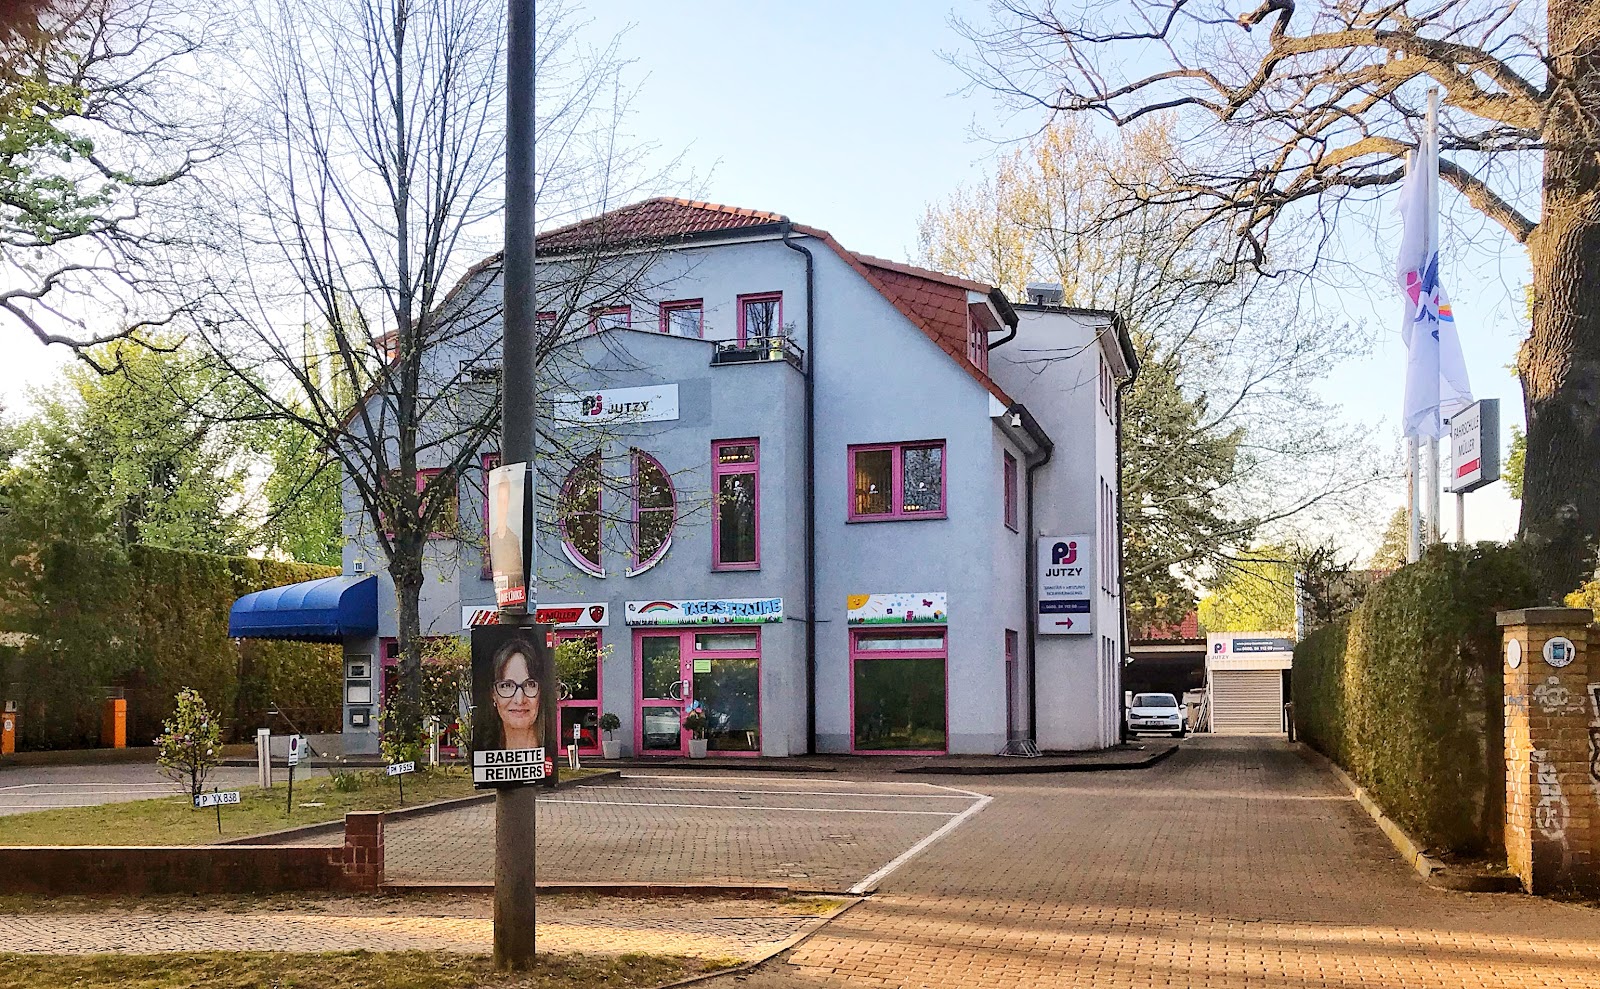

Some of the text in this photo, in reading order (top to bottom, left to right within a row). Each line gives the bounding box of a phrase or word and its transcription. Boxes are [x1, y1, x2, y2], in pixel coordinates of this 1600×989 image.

[607, 401, 650, 414] JUTZY
[1454, 415, 1479, 440] FAHRSCHULE
[1458, 438, 1475, 457] MÜLLER
[1045, 567, 1083, 577] JUTZY
[485, 749, 542, 764] BABETTE
[485, 765, 543, 781] REIMERS
[202, 795, 208, 805] P
